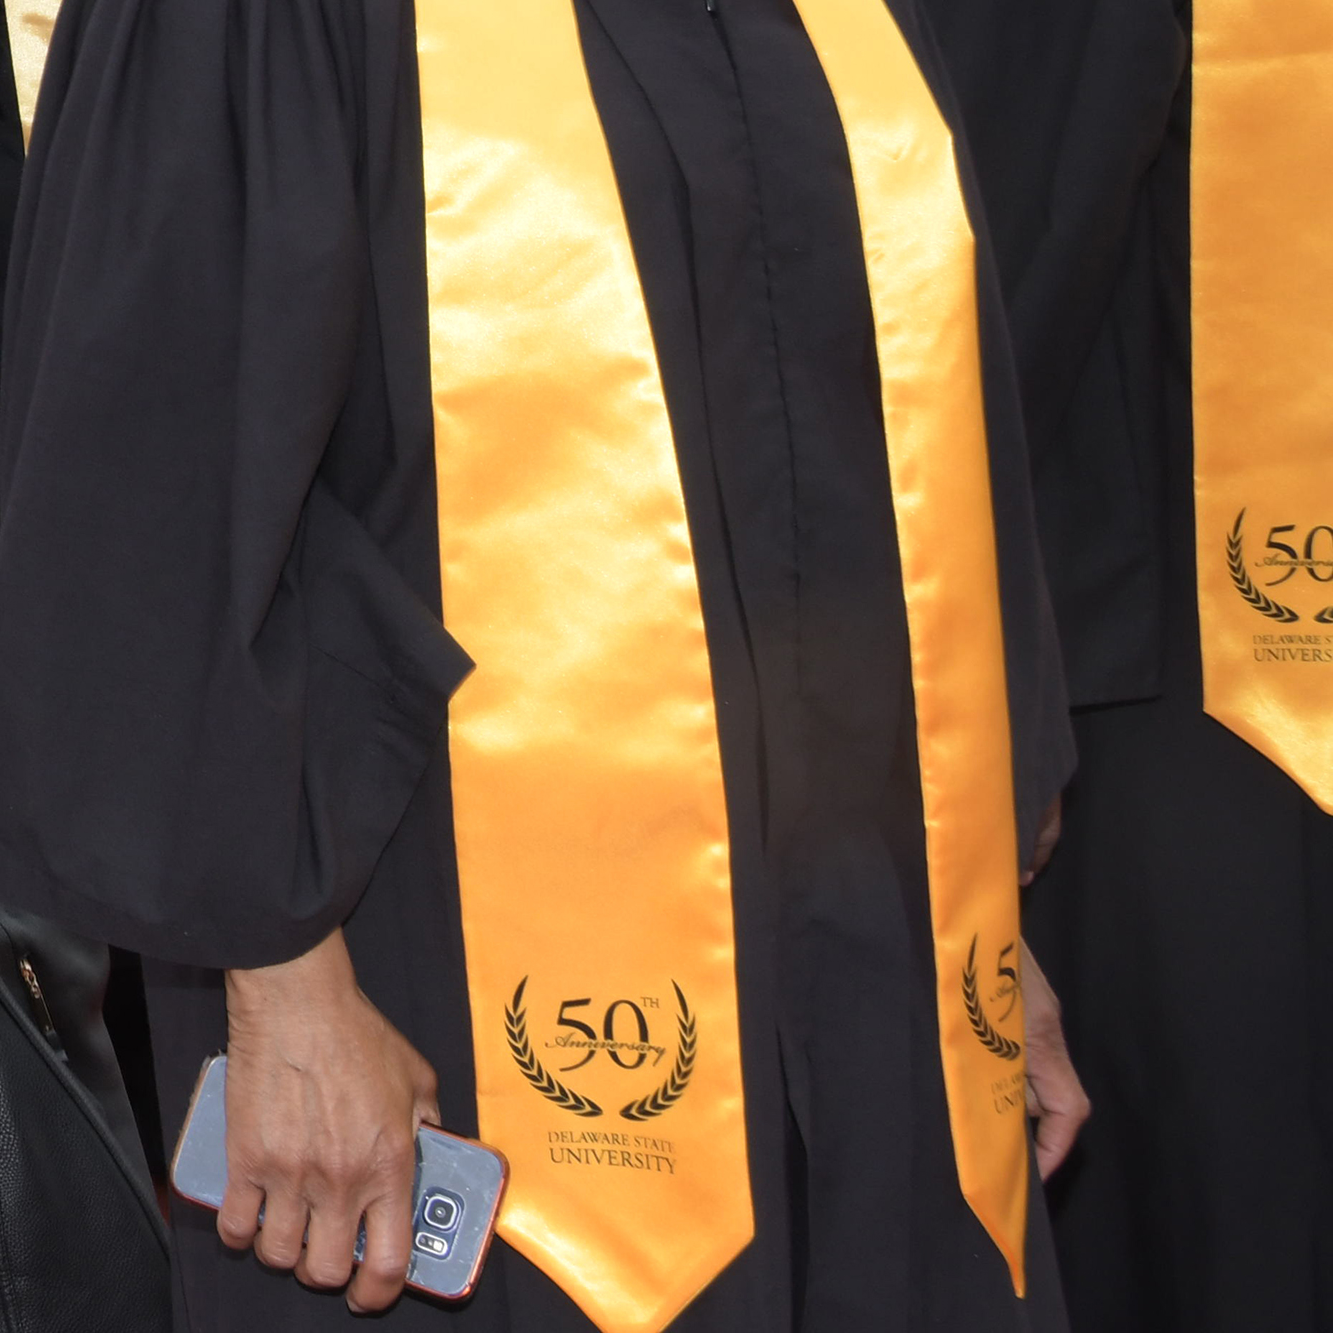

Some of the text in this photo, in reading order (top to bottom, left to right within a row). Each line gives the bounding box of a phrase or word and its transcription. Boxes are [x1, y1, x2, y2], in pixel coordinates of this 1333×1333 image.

[1264, 524, 1333, 586] 50
[1252, 634, 1323, 645] DELAWARE
[545, 1032, 667, 1067] Anniversary
[557, 996, 661, 1072] 50 TH
[547, 1131, 675, 1153] DELAWARE STATE
[549, 1147, 677, 1175] UNIVERSITY
